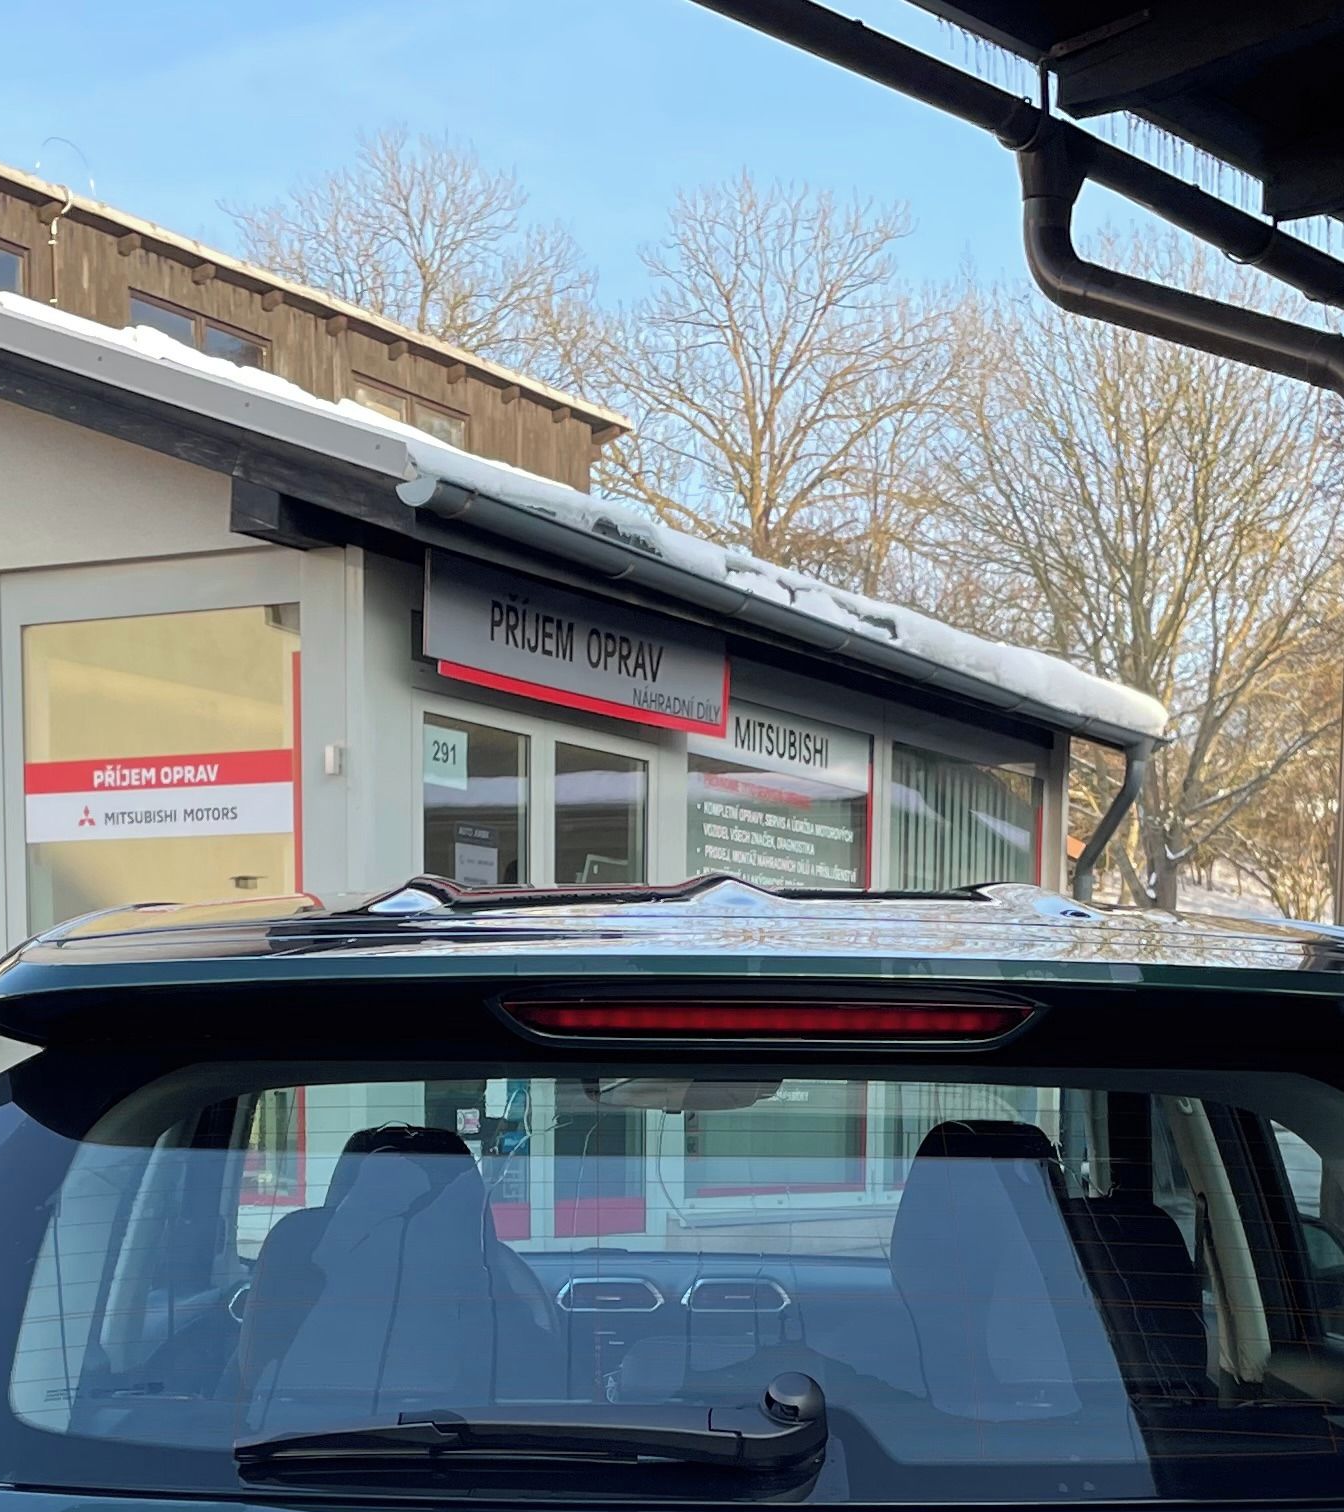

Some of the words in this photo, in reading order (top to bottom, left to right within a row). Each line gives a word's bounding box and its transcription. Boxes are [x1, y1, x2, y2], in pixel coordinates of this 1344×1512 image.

[489, 594, 575, 663] PŘÍJEM
[587, 627, 665, 683] OPRAV
[633, 685, 694, 717] NÁHRADNÍ
[696, 695, 721, 724] DÍLY
[432, 740, 457, 766] 291
[734, 716, 829, 769] MITSUBISHI
[93, 765, 156, 788] PŘÍJEM
[160, 764, 219, 785] OPRAV
[104, 809, 177, 826] MITSUBISHI
[183, 806, 238, 822] MOTORS
